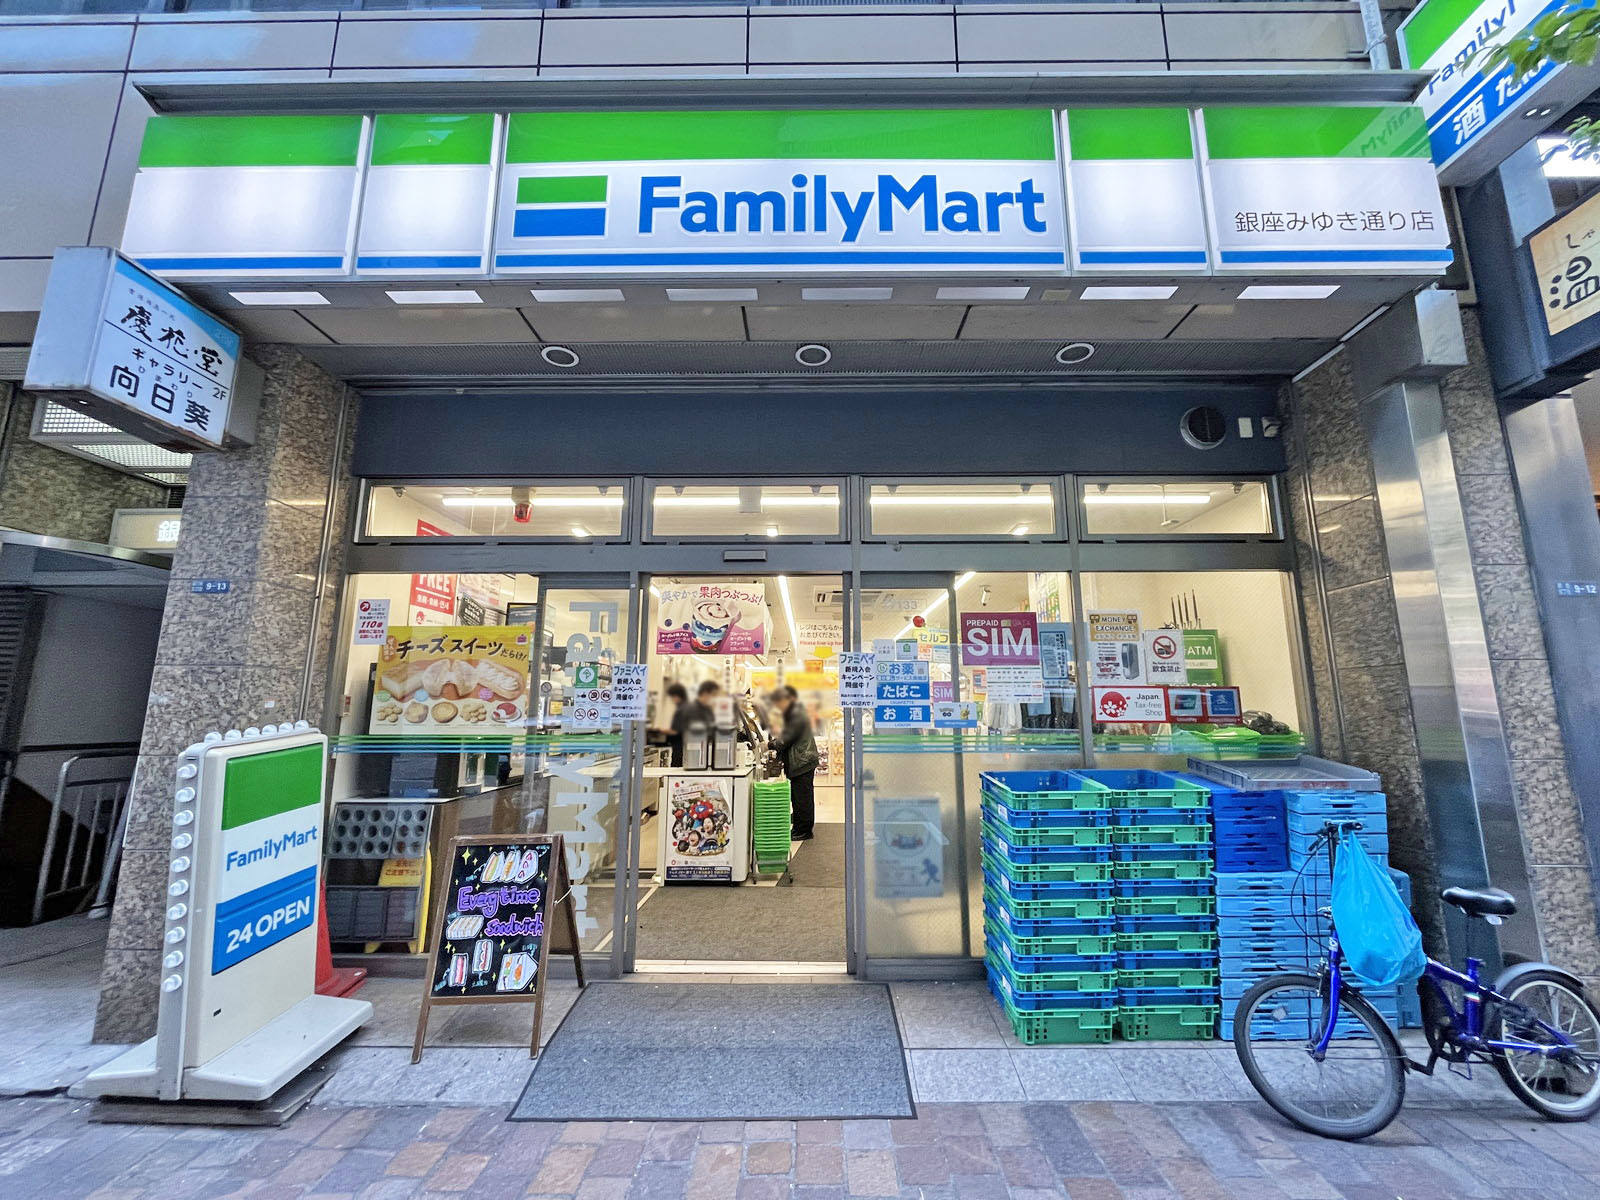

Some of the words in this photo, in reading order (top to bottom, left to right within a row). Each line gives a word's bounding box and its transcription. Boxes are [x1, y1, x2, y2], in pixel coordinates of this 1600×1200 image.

[1452, 94, 1487, 145] 酒
[638, 172, 1047, 243] FamilyMart
[1234, 210, 1435, 233] 銀座みゆき通り店
[132, 348, 203, 390] ギャラリー
[212, 386, 227, 401] 2F
[109, 364, 212, 432] 向日葵
[206, 582, 227, 591] 9-13
[966, 619, 999, 627] PREPAID
[967, 627, 1033, 657] SIM
[839, 653, 876, 664] ファミペイ
[613, 665, 648, 676] ファミペイ
[888, 663, 915, 676] お薬
[882, 685, 922, 699] たばこ
[934, 687, 953, 699] SIM
[1145, 709, 1163, 717] Shop
[226, 825, 318, 872] FamilyMart
[226, 922, 254, 954] 24
[254, 896, 311, 938] OPEN
